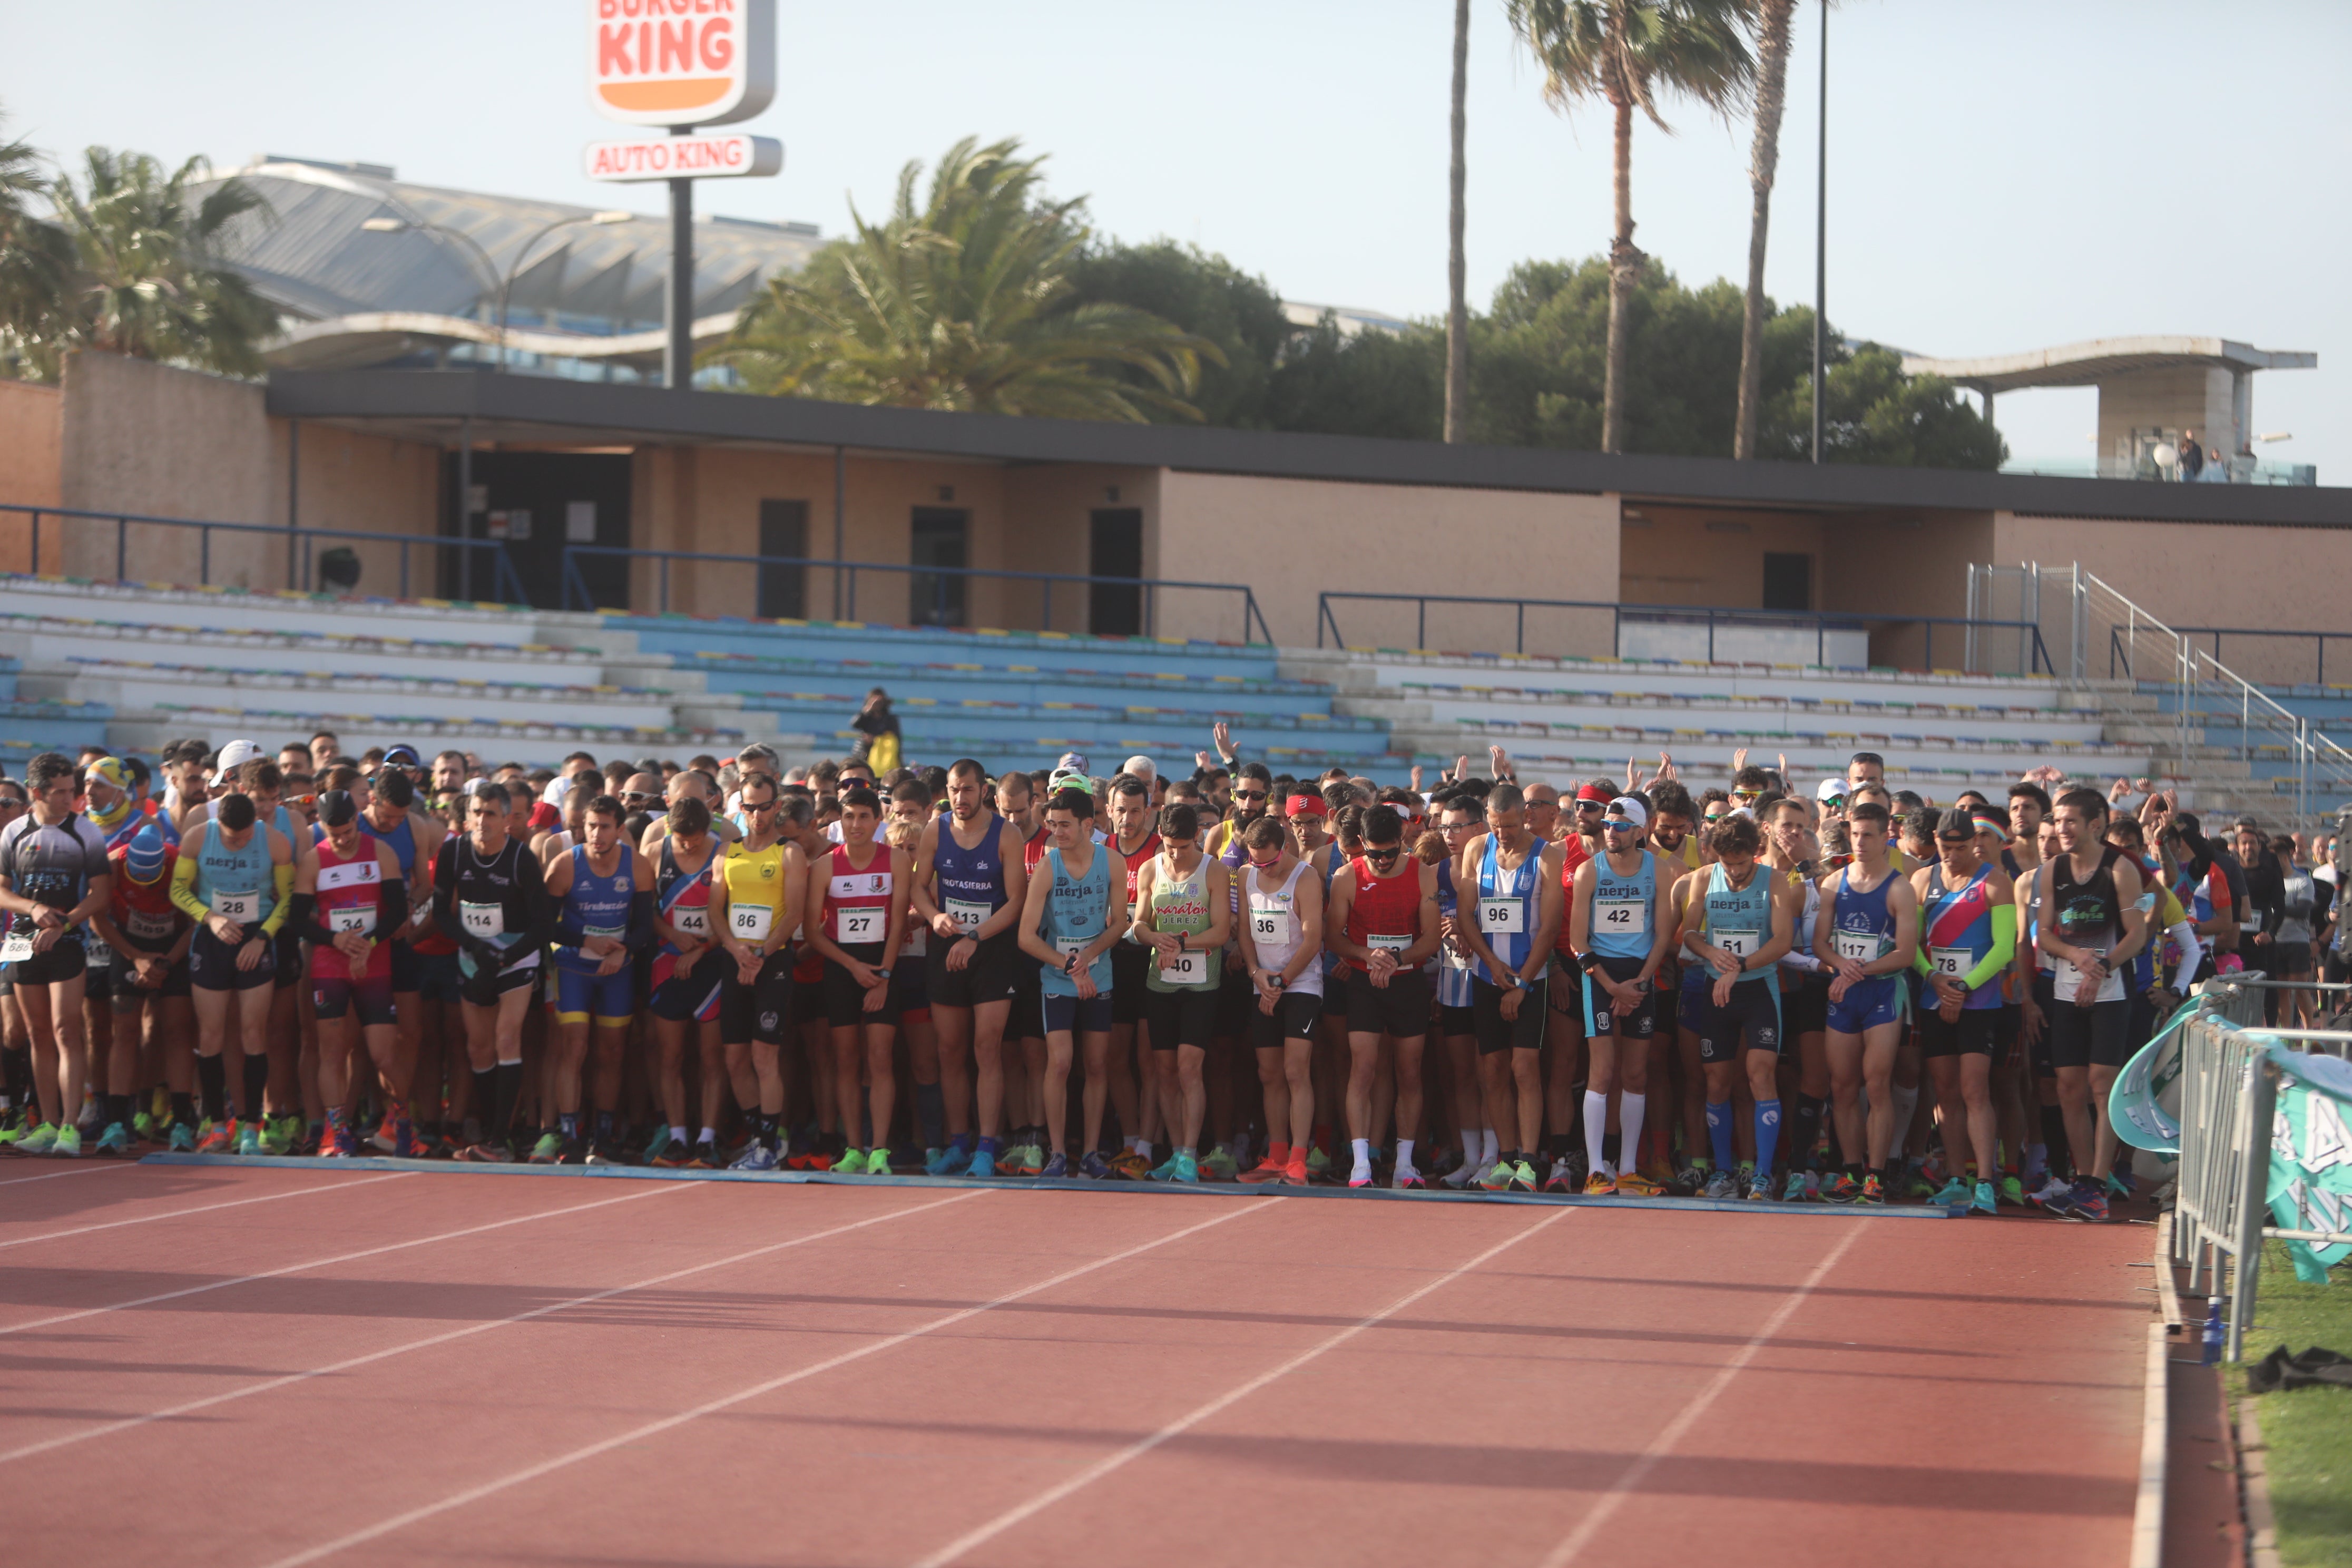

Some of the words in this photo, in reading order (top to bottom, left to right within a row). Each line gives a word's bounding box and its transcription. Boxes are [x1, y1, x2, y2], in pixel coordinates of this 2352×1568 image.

[600, 17, 734, 76] KING
[594, 144, 669, 175] AUTO
[674, 140, 742, 170] KING
[205, 856, 247, 870] nerja
[1055, 885, 1093, 899] nerja
[1598, 885, 1640, 898] nerja
[222, 901, 244, 913] 28
[1710, 898, 1751, 913] nerja
[466, 914, 492, 926] 114
[738, 914, 757, 927] 86
[953, 911, 979, 924] 113
[1488, 908, 1508, 922] 96
[1607, 909, 1630, 923] 42
[342, 918, 363, 931] 34
[683, 916, 704, 929] 44
[848, 918, 870, 931] 27
[1257, 919, 1275, 933] 36
[1723, 940, 1742, 953] 51
[1842, 943, 1866, 956] 117
[1170, 959, 1192, 972] 40
[1937, 958, 1956, 972] 78
